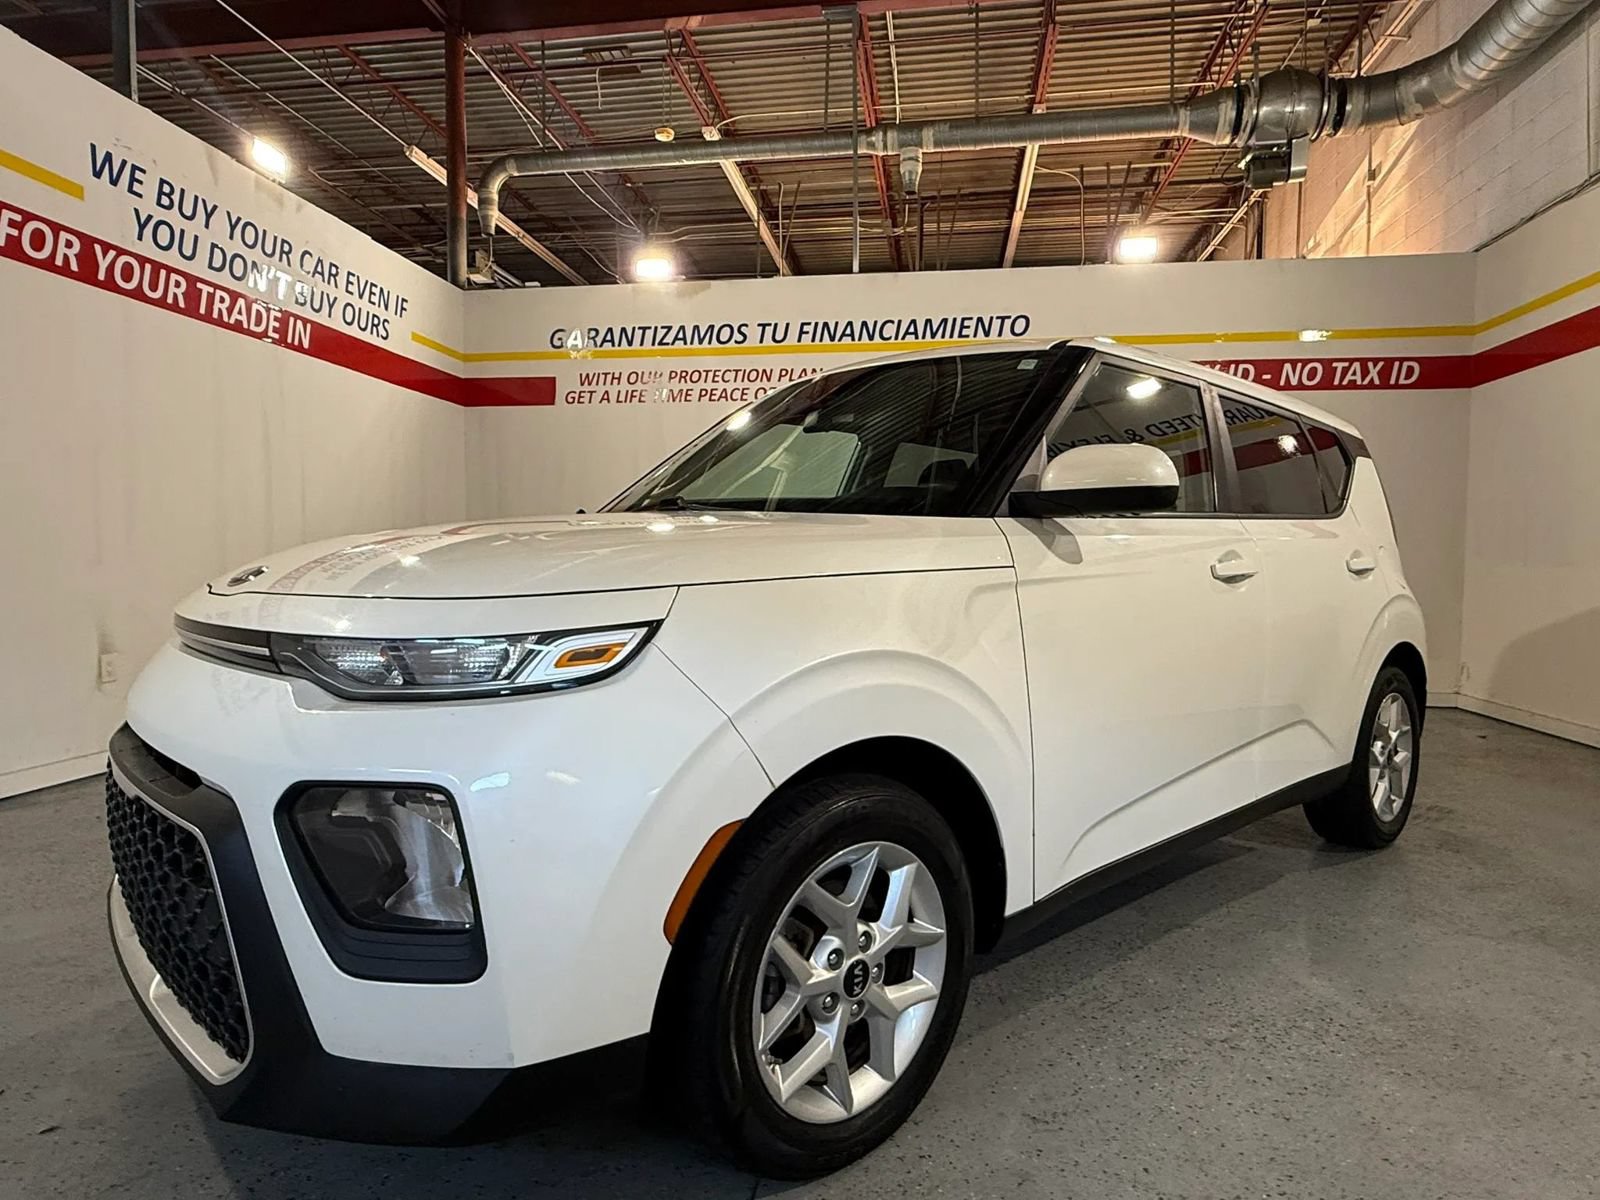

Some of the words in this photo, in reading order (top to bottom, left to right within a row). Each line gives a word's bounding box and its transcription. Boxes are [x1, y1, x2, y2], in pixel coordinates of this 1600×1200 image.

[90, 142, 146, 199] WE
[156, 177, 219, 230] BUY
[226, 210, 293, 268] YOUR
[300, 250, 340, 290] CAR
[345, 270, 390, 312] EVEN
[394, 294, 409, 318] IF
[0, 208, 81, 272] FOR
[93, 243, 187, 308] YOUR
[196, 281, 282, 340] TRADE
[286, 316, 312, 349] IN
[133, 207, 199, 261] YOU
[207, 242, 293, 300] DON'T
[294, 280, 338, 318] BUY
[342, 302, 390, 341] OURS
[549, 322, 749, 350] GARANTIZAMOS
[757, 322, 790, 344] TU
[797, 314, 1032, 343] FINANCIAMIENTO
[579, 371, 623, 387] WITH
[668, 368, 774, 384] PROTECTION
[1279, 362, 1323, 386] NO
[1331, 360, 1384, 386] TAX
[1389, 360, 1421, 385] ID
[565, 390, 596, 405] GET
[599, 389, 614, 404] A
[698, 387, 750, 402] PEACE
[755, 387, 777, 400] O
[853, 963, 863, 995] KIA
